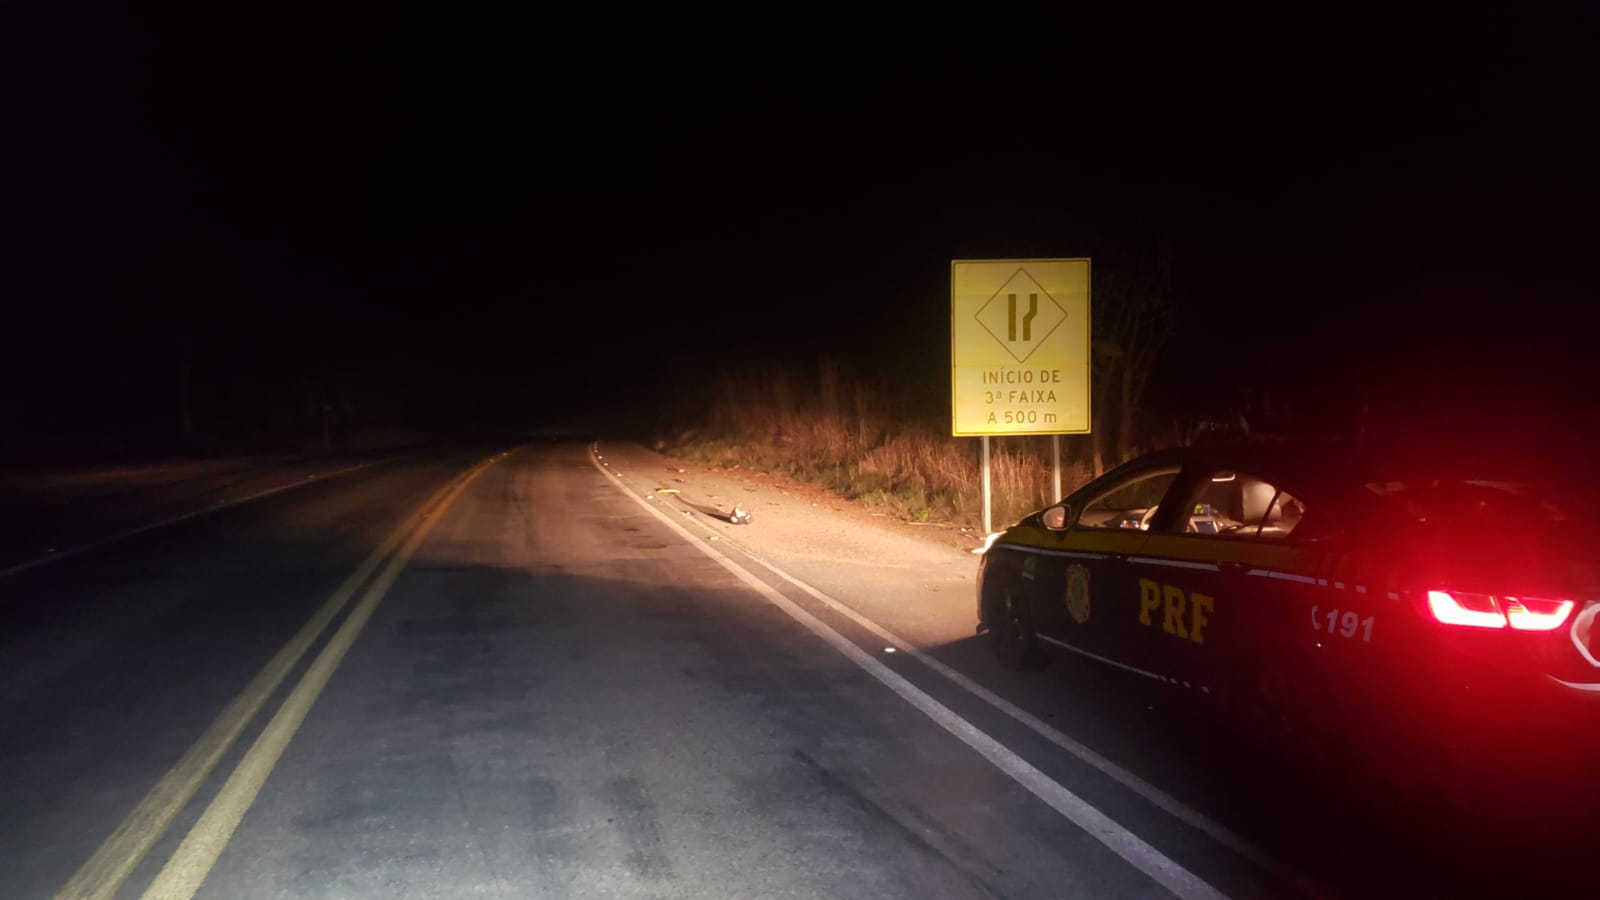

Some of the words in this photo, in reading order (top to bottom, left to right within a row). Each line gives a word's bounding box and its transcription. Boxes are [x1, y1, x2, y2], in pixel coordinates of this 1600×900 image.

[983, 367, 1033, 384] INÍCIO
[1040, 370, 1062, 383] DE
[1009, 390, 1057, 403] FAIXA
[987, 411, 997, 424] A
[1005, 410, 1037, 424] 500
[1044, 412, 1057, 423] m
[1138, 577, 1215, 646] PRF
[1327, 608, 1376, 642] 191
